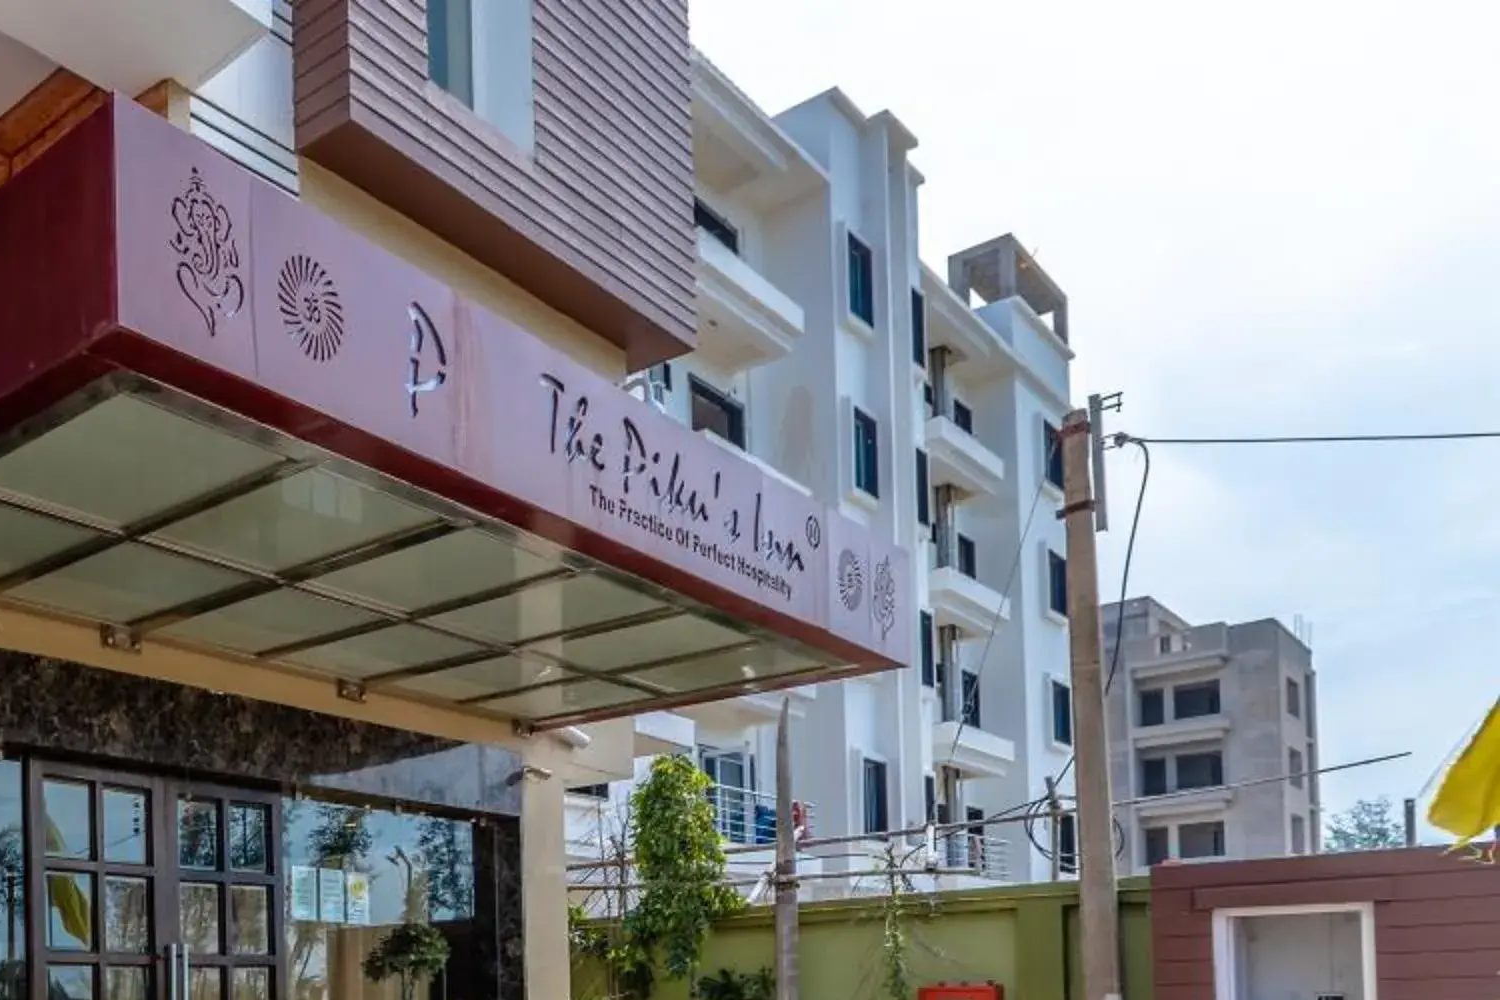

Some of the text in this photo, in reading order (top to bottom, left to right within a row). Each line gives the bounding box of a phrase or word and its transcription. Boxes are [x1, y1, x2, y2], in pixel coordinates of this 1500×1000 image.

[539, 372, 605, 471] The
[754, 492, 804, 572] Inn
[589, 484, 792, 601] The Practice Of Perfect Hospitality
